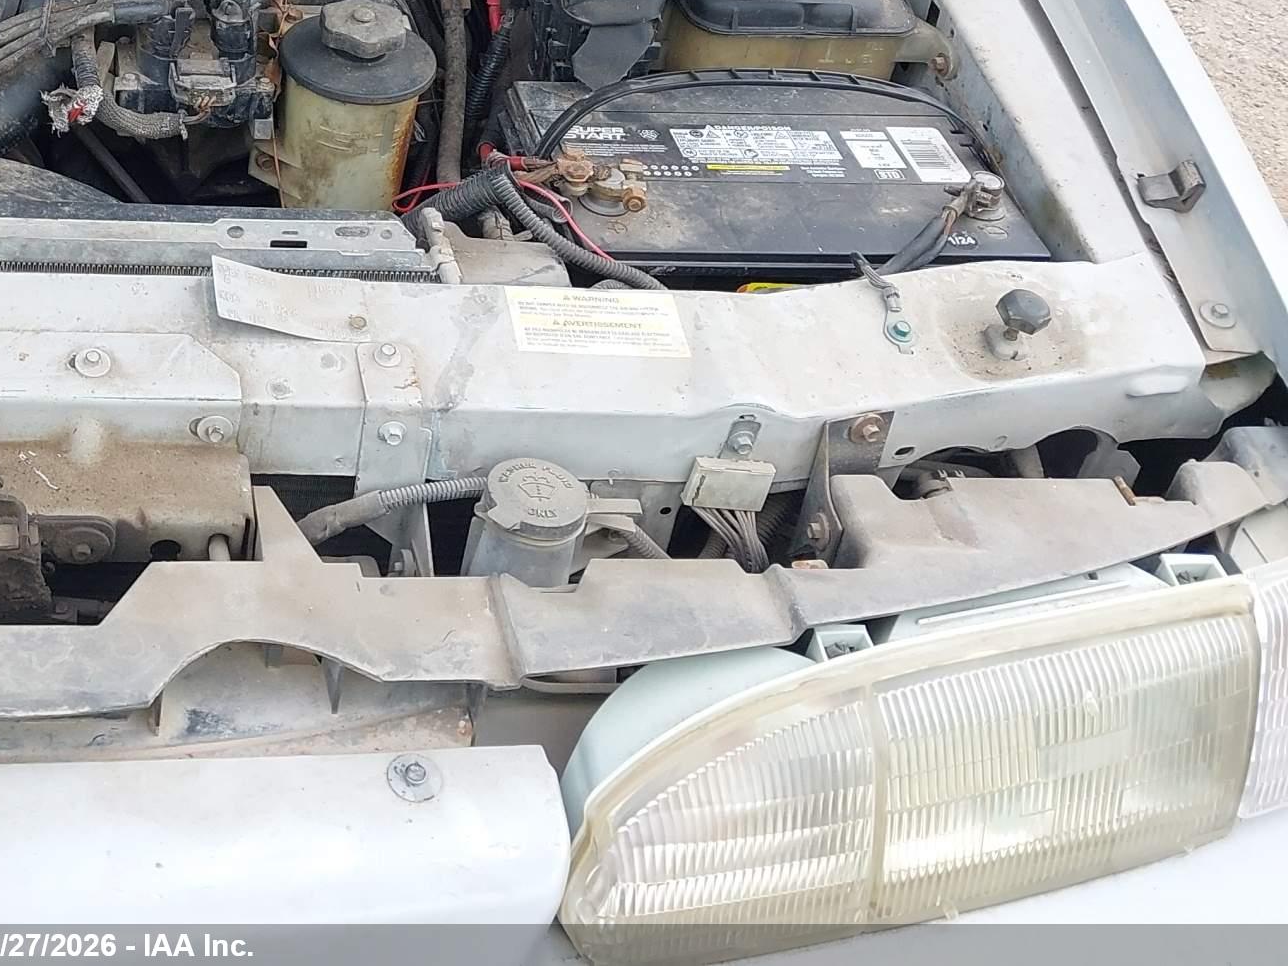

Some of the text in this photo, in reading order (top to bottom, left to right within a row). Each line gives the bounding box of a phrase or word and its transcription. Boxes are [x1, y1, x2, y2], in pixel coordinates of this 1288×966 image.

[568, 124, 624, 134] SUPER
[563, 133, 626, 141] START
[879, 171, 901, 179] STD
[572, 295, 620, 304] WARNING
[563, 319, 642, 329] AVERTISSEMENT
[527, 506, 558, 519] ONLY
